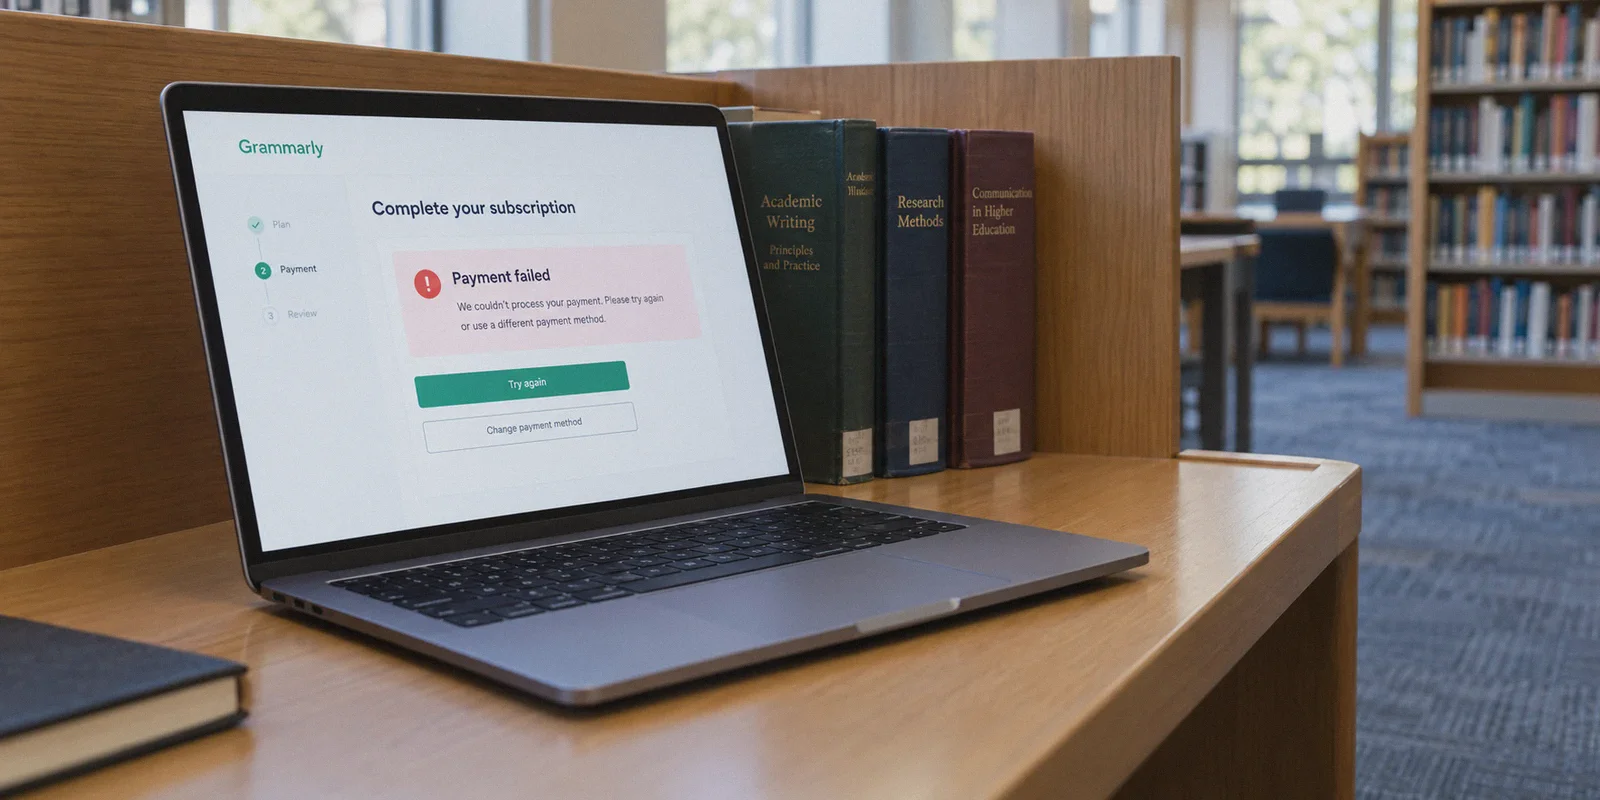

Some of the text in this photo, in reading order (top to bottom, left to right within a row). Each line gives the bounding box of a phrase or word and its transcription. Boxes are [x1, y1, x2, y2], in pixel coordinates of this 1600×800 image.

[238, 138, 324, 158] Grammarly
[972, 186, 1032, 199] Communication
[760, 194, 823, 208] Academic
[897, 195, 944, 209] Research
[371, 199, 576, 219] Complete your subscription
[972, 204, 1014, 220] in Higher
[272, 220, 291, 229] Plan
[766, 214, 816, 232] Writing
[897, 215, 944, 228] Methods
[972, 223, 1016, 236] Education
[769, 245, 813, 257] Principles
[260, 265, 318, 275] 2 Payment
[763, 259, 820, 271] and Practice
[451, 268, 551, 288] Payment failed
[456, 301, 472, 312] We
[511, 300, 545, 311] process
[546, 300, 564, 310] your
[566, 297, 604, 309] payment.
[604, 296, 630, 305] Please
[630, 296, 642, 305] try
[643, 294, 664, 304] again
[268, 310, 318, 320] 3 Review
[461, 314, 607, 332] or use a different payment method.
[508, 377, 547, 390] Try again
[486, 417, 583, 435] Change payment method
